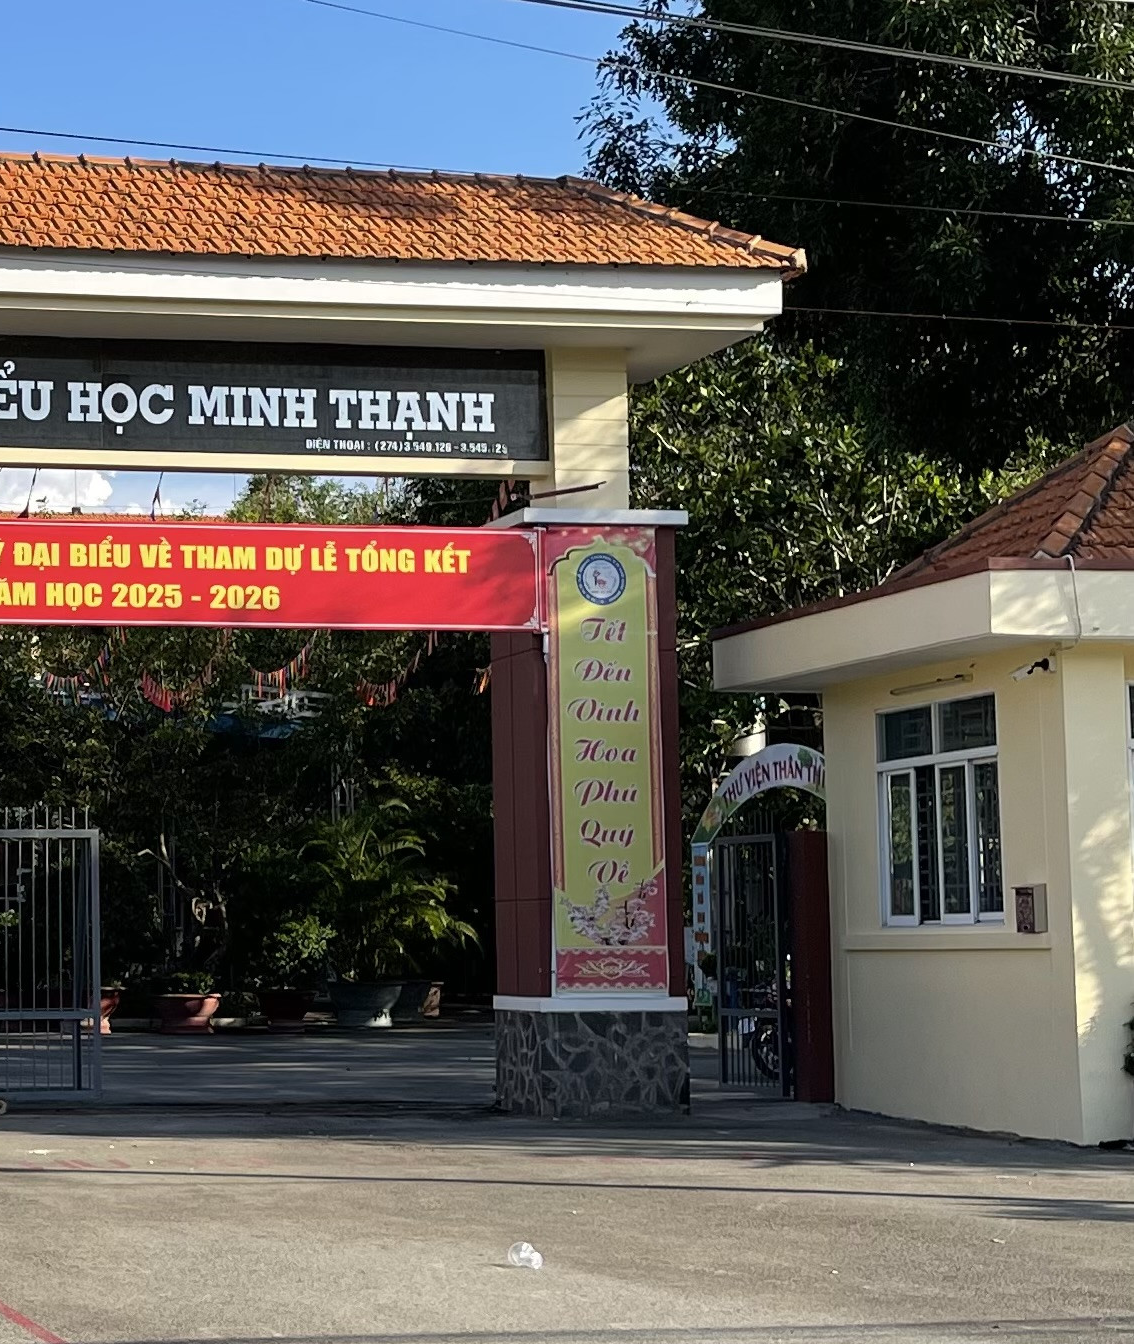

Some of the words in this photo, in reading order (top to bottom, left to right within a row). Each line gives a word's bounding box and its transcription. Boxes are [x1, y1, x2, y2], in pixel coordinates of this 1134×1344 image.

[67, 381, 174, 435] HỌC
[187, 385, 317, 428] MINH
[329, 389, 496, 441] THẠNH
[13, 541, 60, 570] ĐẠI
[70, 535, 131, 569] BIỂU
[139, 536, 172, 569] VỀ
[180, 544, 256, 571] THAM
[266, 544, 305, 575] DỰ
[311, 540, 338, 572] LỄ
[345, 540, 415, 573] TỔNG
[424, 542, 471, 574] KẾT
[45, 581, 103, 611] HỌC
[111, 582, 182, 608] 2025
[209, 584, 280, 610] 2026
[580, 617, 627, 642] Tết
[574, 659, 631, 682] Đến
[567, 698, 640, 723] Vinh
[574, 739, 636, 762] Hoa
[574, 779, 638, 806] Phú
[723, 771, 744, 808] THƯ
[745, 760, 771, 790] VIỆN
[580, 819, 634, 847] Quý
[588, 860, 630, 884] Về
